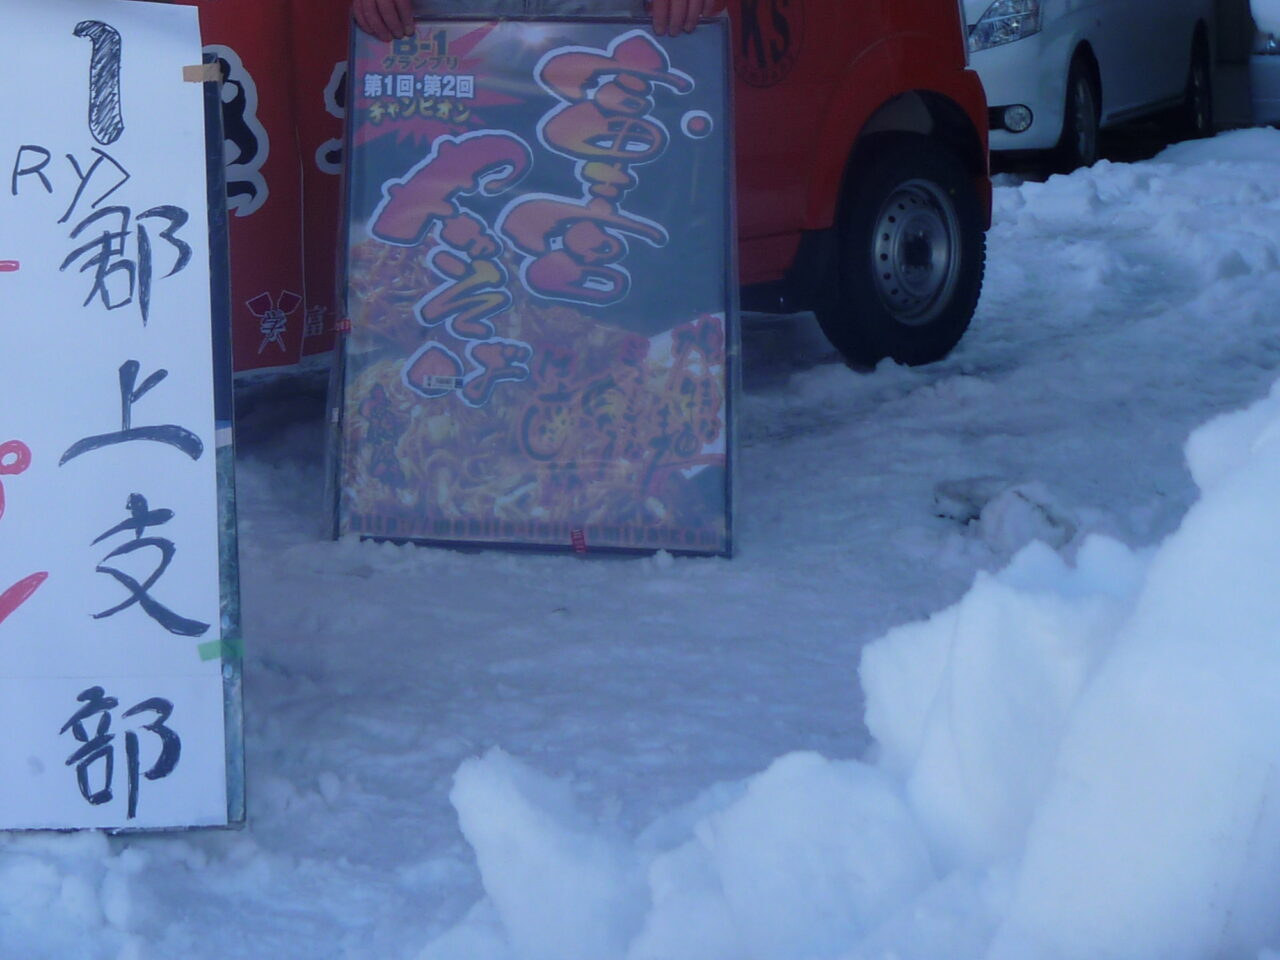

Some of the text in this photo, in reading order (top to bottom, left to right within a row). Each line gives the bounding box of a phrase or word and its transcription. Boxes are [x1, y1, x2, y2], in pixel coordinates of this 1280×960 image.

[383, 55, 458, 70] グランプリ
